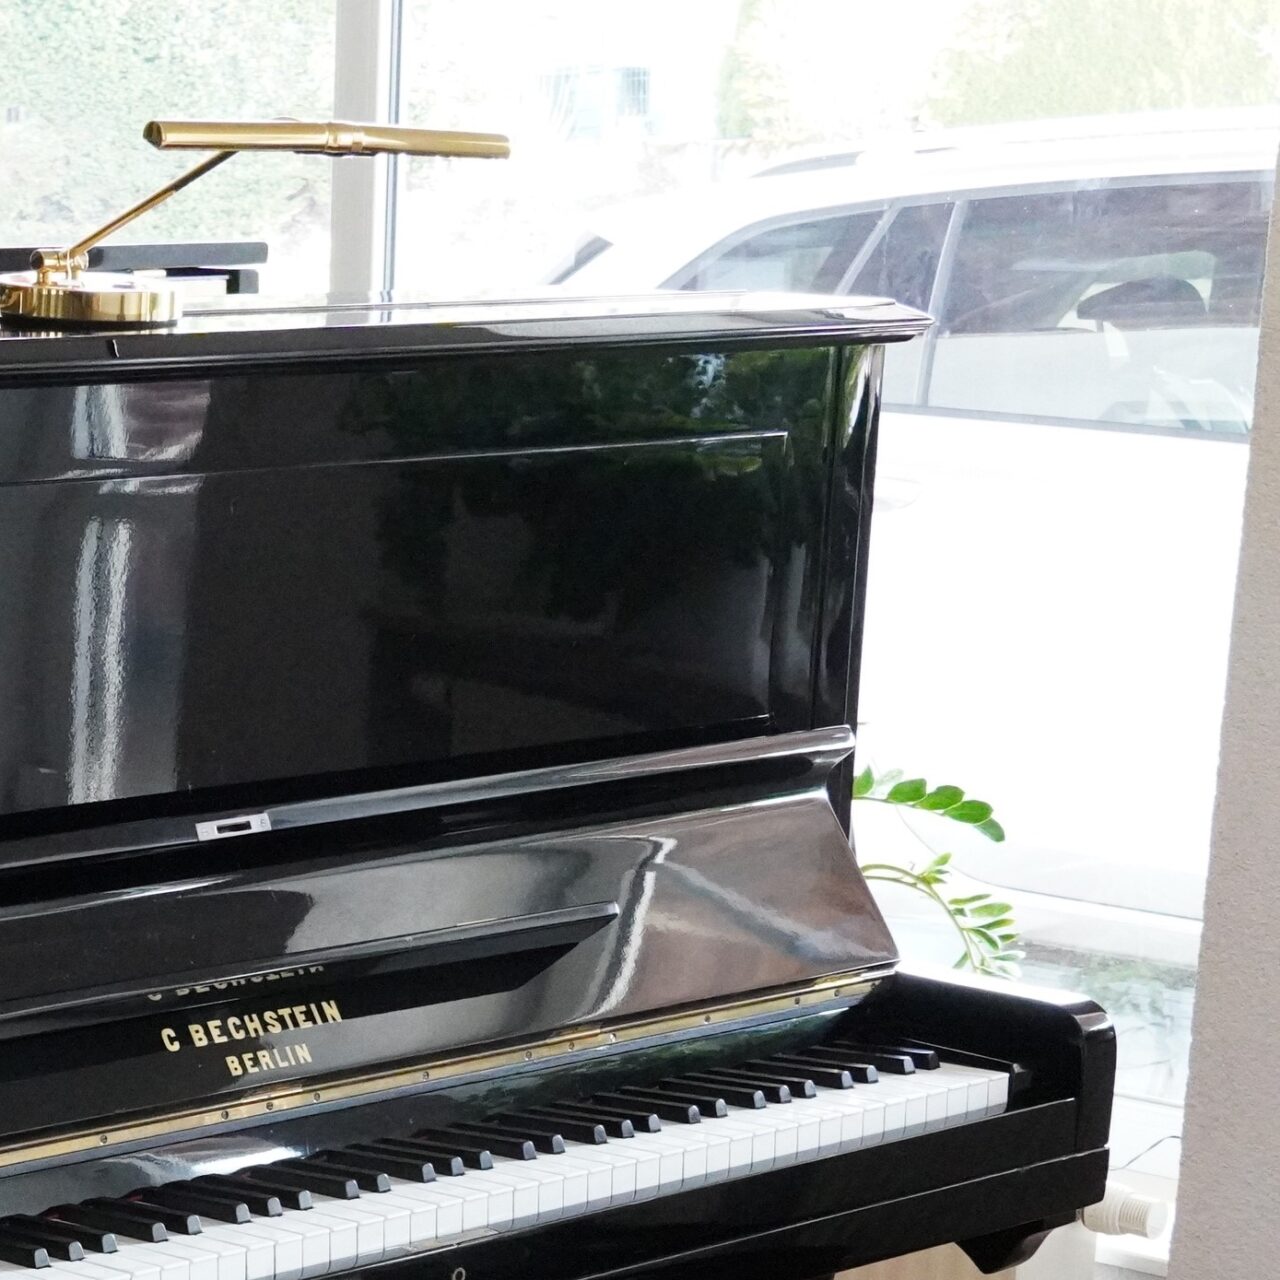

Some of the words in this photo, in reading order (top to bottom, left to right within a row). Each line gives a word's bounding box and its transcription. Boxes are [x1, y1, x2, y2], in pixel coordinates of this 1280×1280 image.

[160, 1028, 180, 1052] C
[188, 1000, 342, 1048] BECHSTEIN
[225, 1043, 312, 1077] BERLIN
